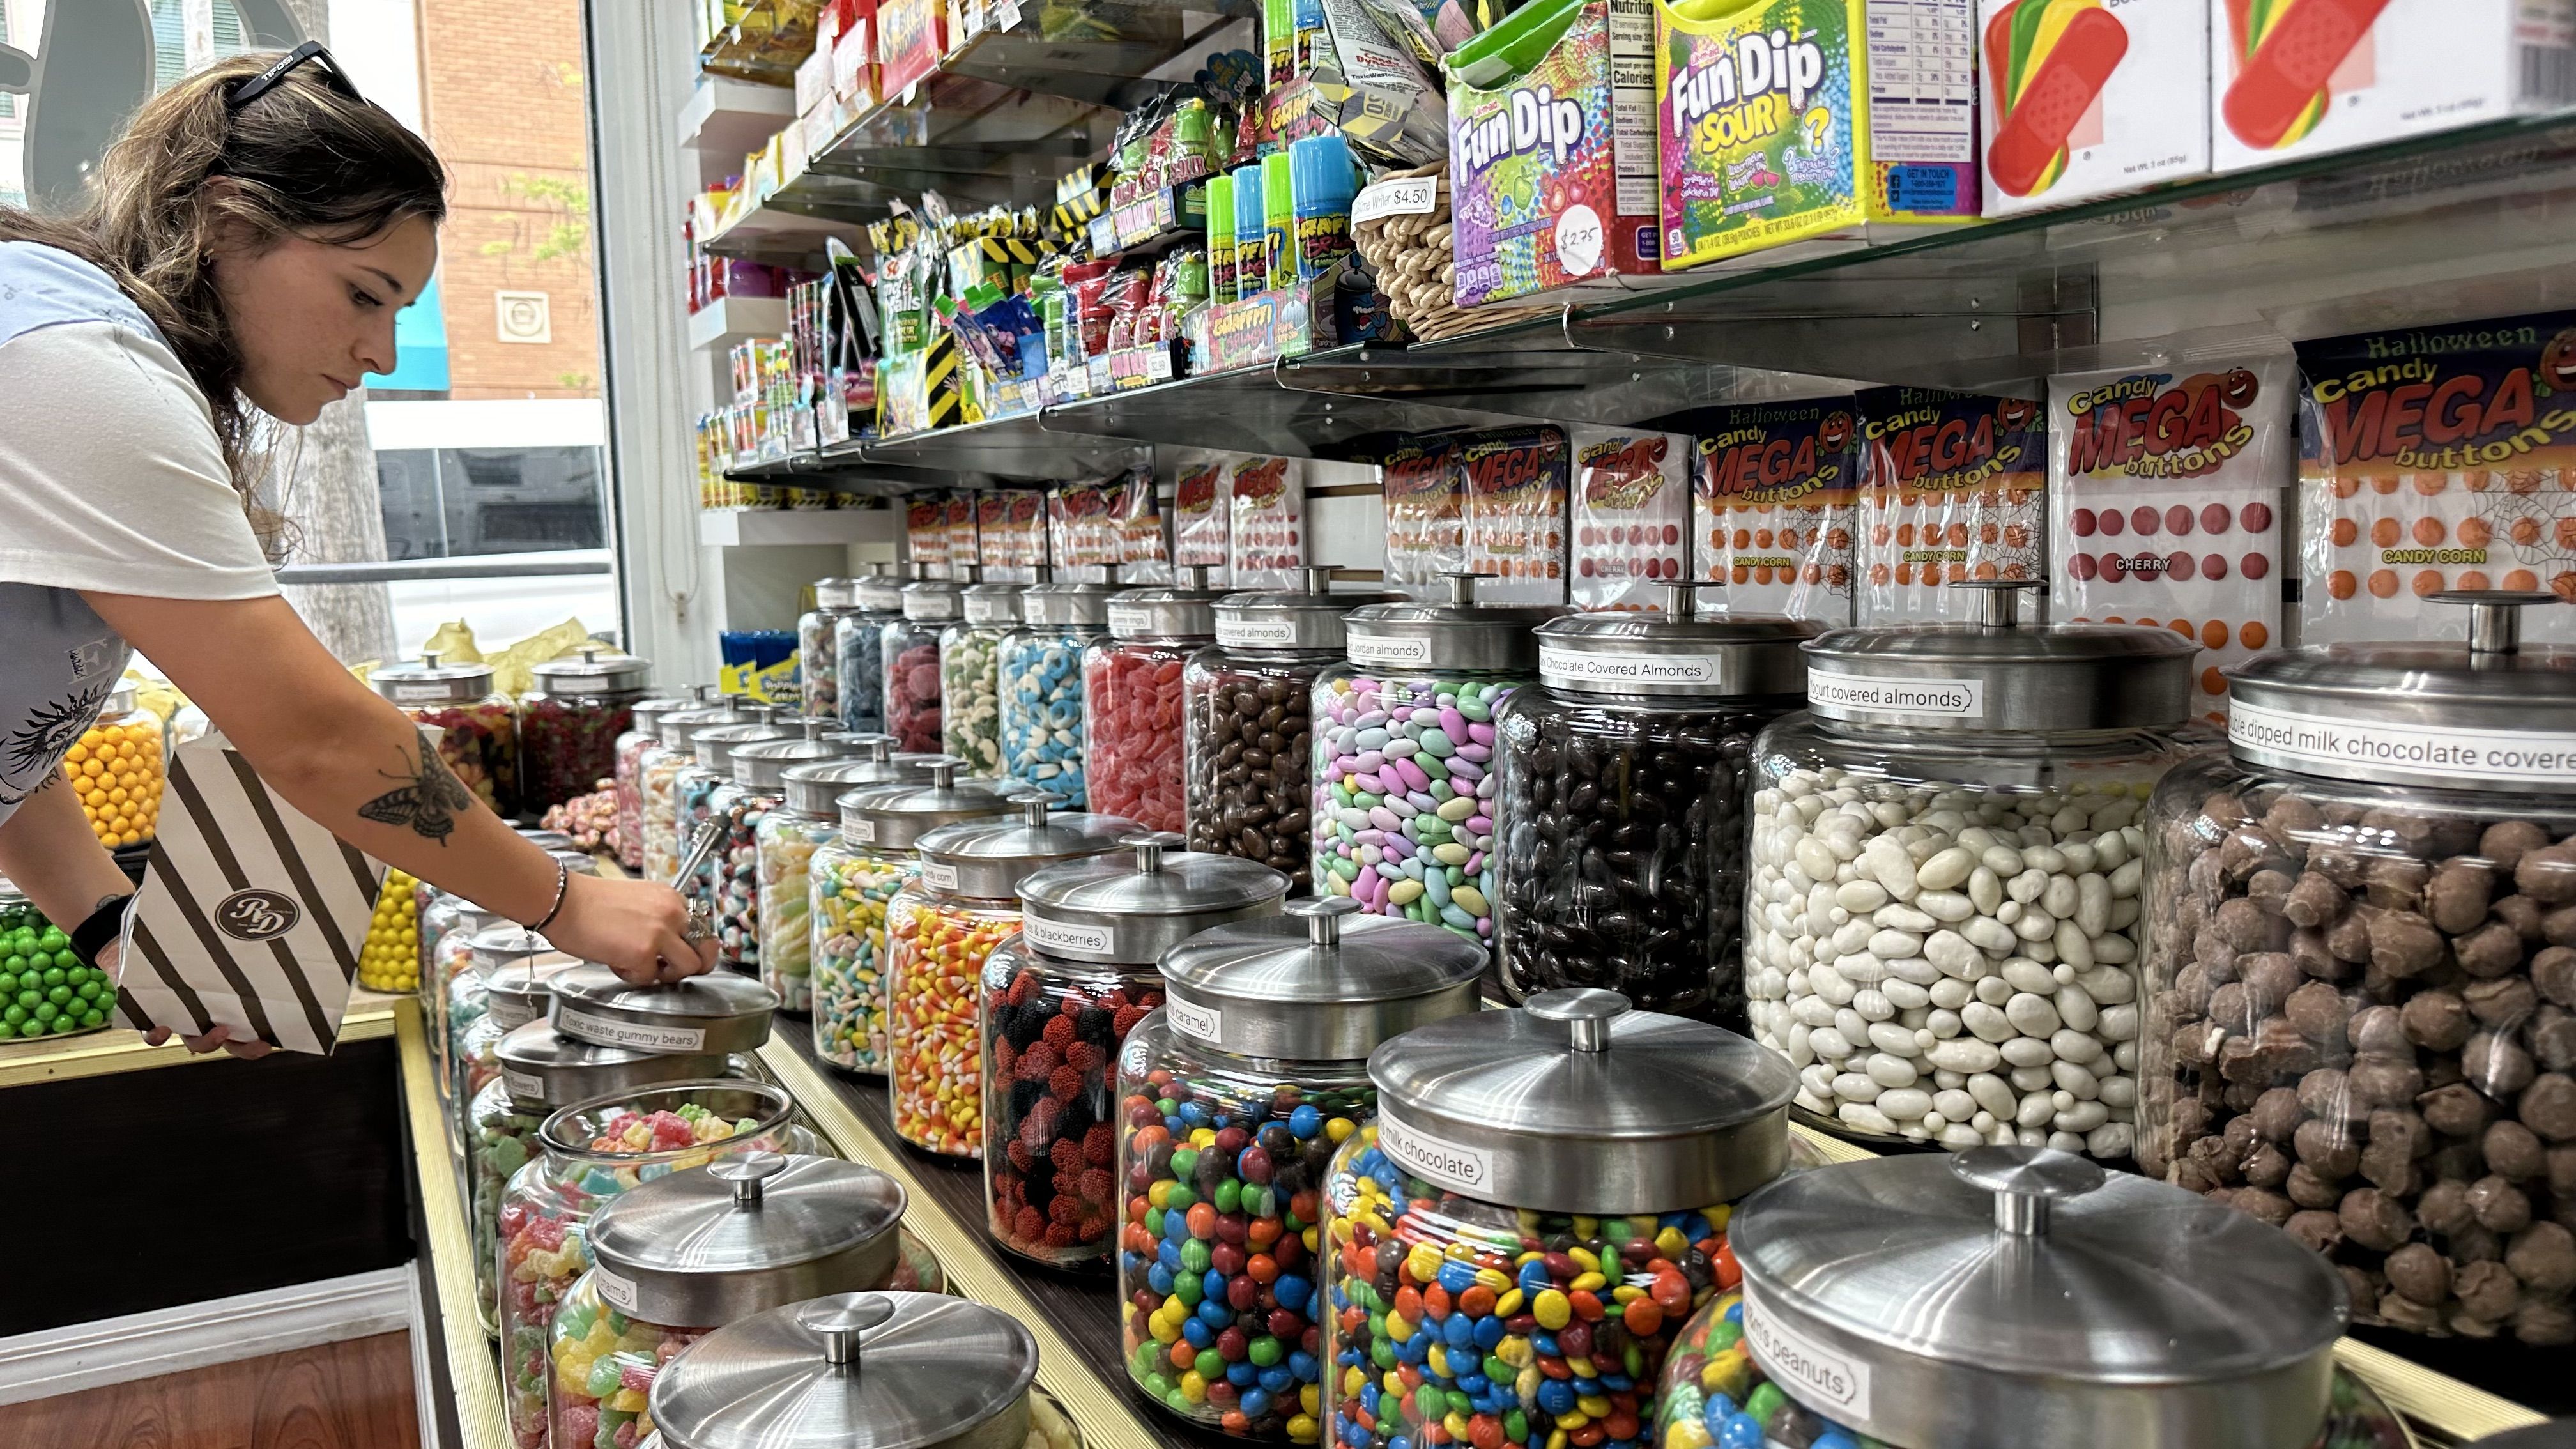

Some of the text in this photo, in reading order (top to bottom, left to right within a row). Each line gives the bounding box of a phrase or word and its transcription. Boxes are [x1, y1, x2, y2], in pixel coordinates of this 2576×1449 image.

[1612, 33, 1631, 42] Serving
[1633, 33, 1643, 42] size
[261, 54, 294, 81] TIFOSI
[1614, 70, 1653, 84] Calories
[1671, 56, 1737, 139] Fun
[1738, 29, 1825, 114] Dip
[1457, 85, 1584, 187] Fun Dip
[1701, 95, 1778, 155] SOUR
[1372, 194, 1392, 210] Writer
[1394, 188, 1427, 205] $4.50
[1561, 227, 1598, 250] $2.75
[2365, 326, 2536, 359] Halloween
[2067, 377, 2158, 415] candy
[2313, 358, 2438, 404] candy
[1729, 407, 1820, 425] Halloween
[1865, 406, 1941, 440] candy
[2068, 385, 2223, 477] MEGA
[2318, 368, 2535, 469] MEGA
[1464, 441, 1509, 463] candy
[1699, 426, 1767, 456] candy
[1867, 414, 1994, 488] MEGA
[2124, 424, 2255, 479] buttons
[2394, 409, 2576, 470] buttons
[1469, 448, 1540, 497] MEGA
[1702, 436, 1816, 500] MEGA
[1741, 464, 1839, 503] buttons
[1912, 445, 2021, 491] buttons
[1491, 470, 1552, 502] buttons
[1600, 564, 1626, 574] CHERRY
[1733, 557, 1790, 567] CANDY CORN
[1903, 551, 1966, 562] CANDY CORN
[2115, 558, 2171, 571] CHERRY
[2382, 549, 2487, 564] CANDY CORN
[1247, 627, 1285, 638] almonds
[1376, 644, 1419, 657] almonds
[1547, 657, 1701, 677] Chocolate Covered Almonds
[1832, 687, 1880, 703] covered
[1884, 688, 1962, 707] almonds
[2248, 721, 2576, 769] dipped milk chocolate covere
[1040, 926, 1101, 947] blackberries
[565, 1014, 693, 1045] Toxic waste gummy bears
[1175, 1008, 1209, 1033] caramel
[1386, 1126, 1474, 1178] milk chocolate
[1772, 1338, 1844, 1395] peanuts
